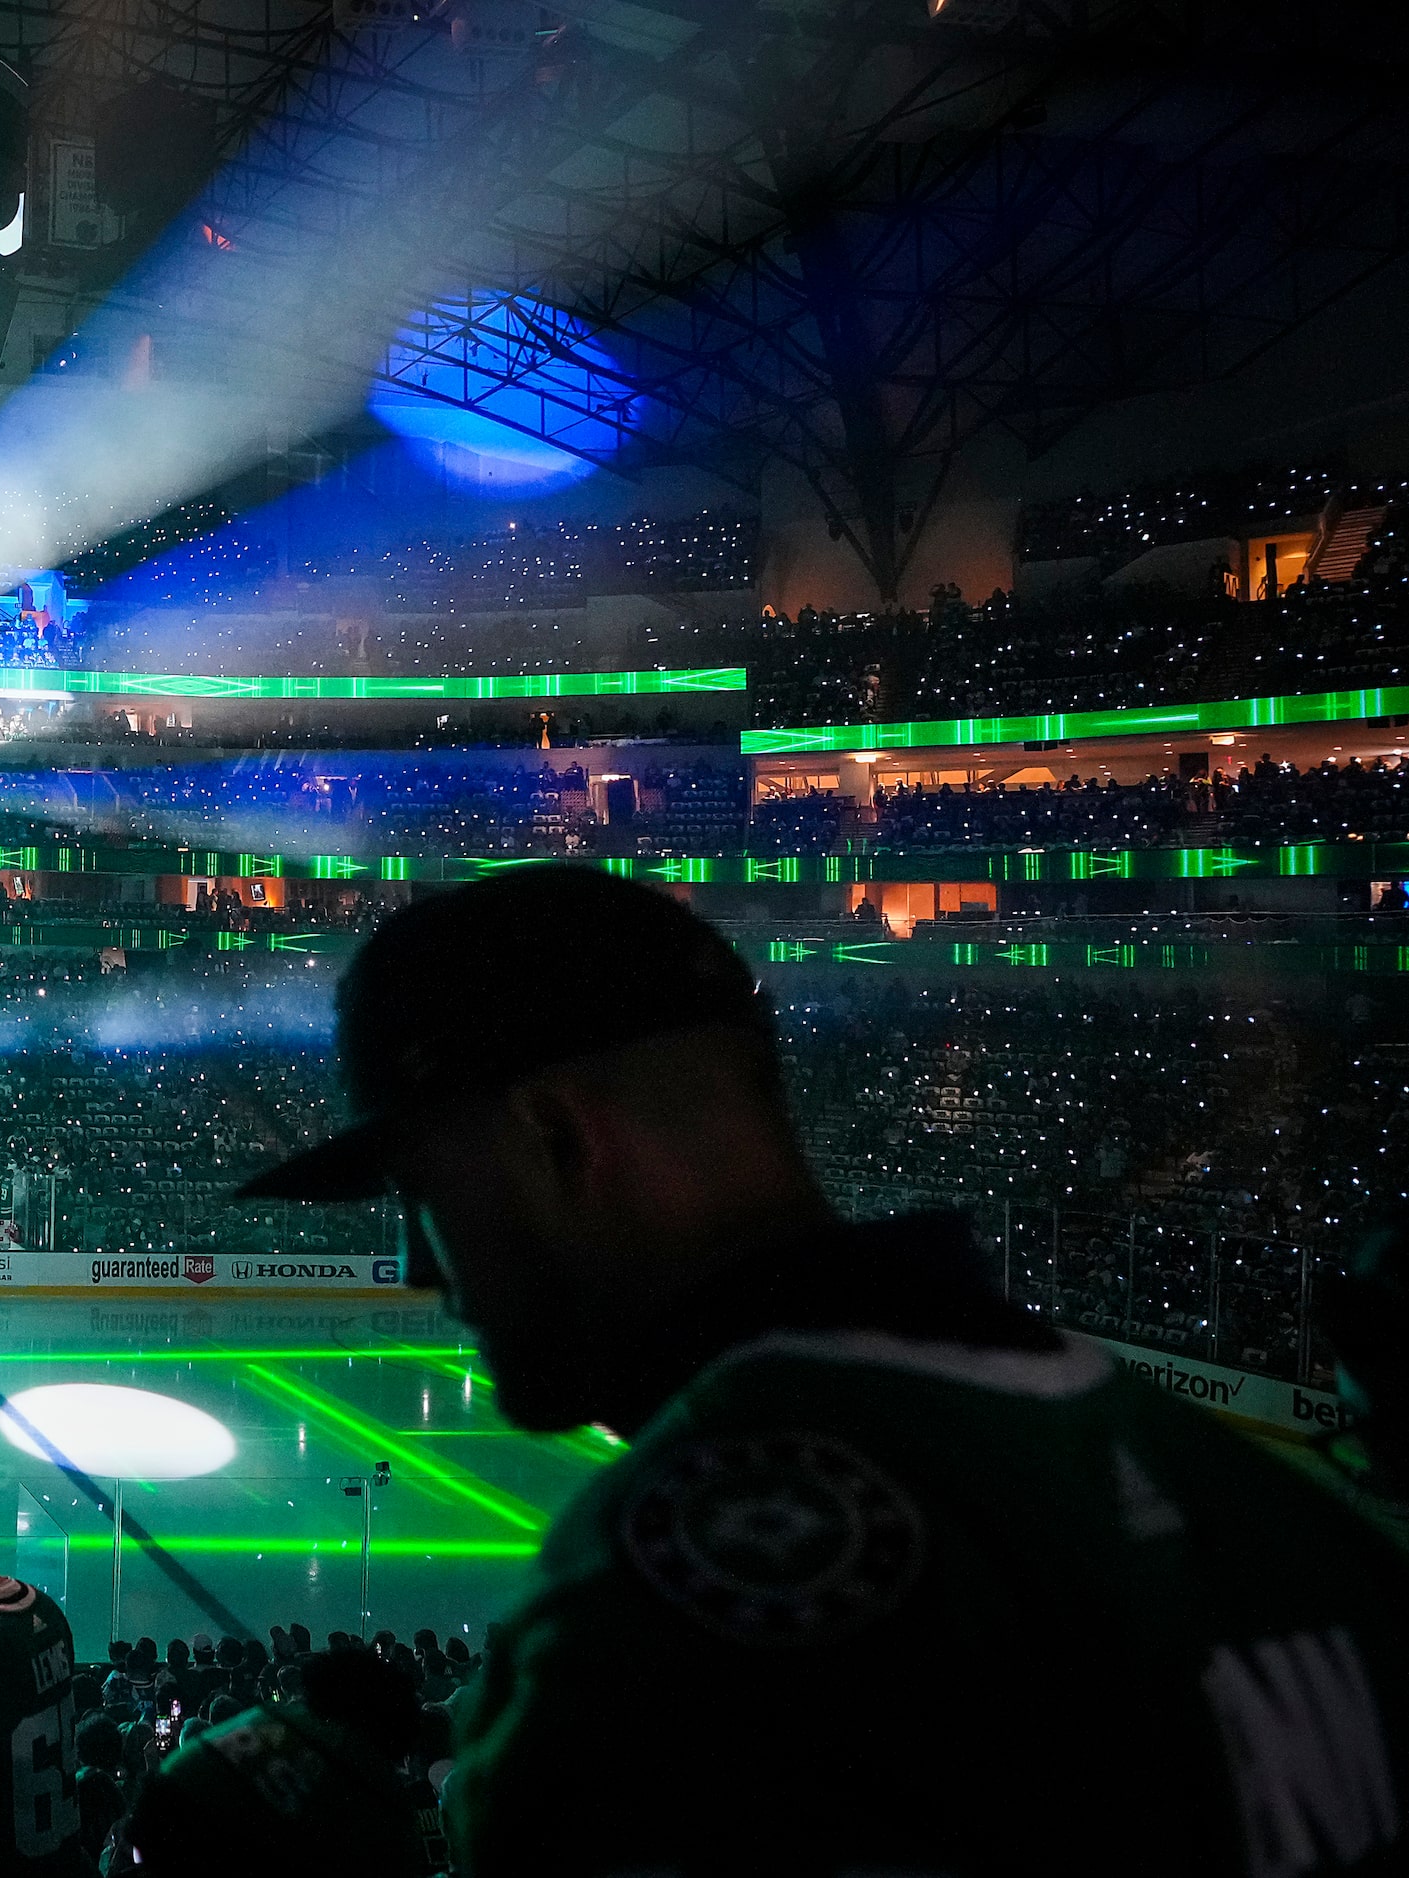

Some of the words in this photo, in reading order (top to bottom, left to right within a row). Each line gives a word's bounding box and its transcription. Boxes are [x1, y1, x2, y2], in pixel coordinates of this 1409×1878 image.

[91, 1256, 179, 1283] guaranteed
[187, 1258, 212, 1275] Rate
[256, 1263, 357, 1278] HONDA
